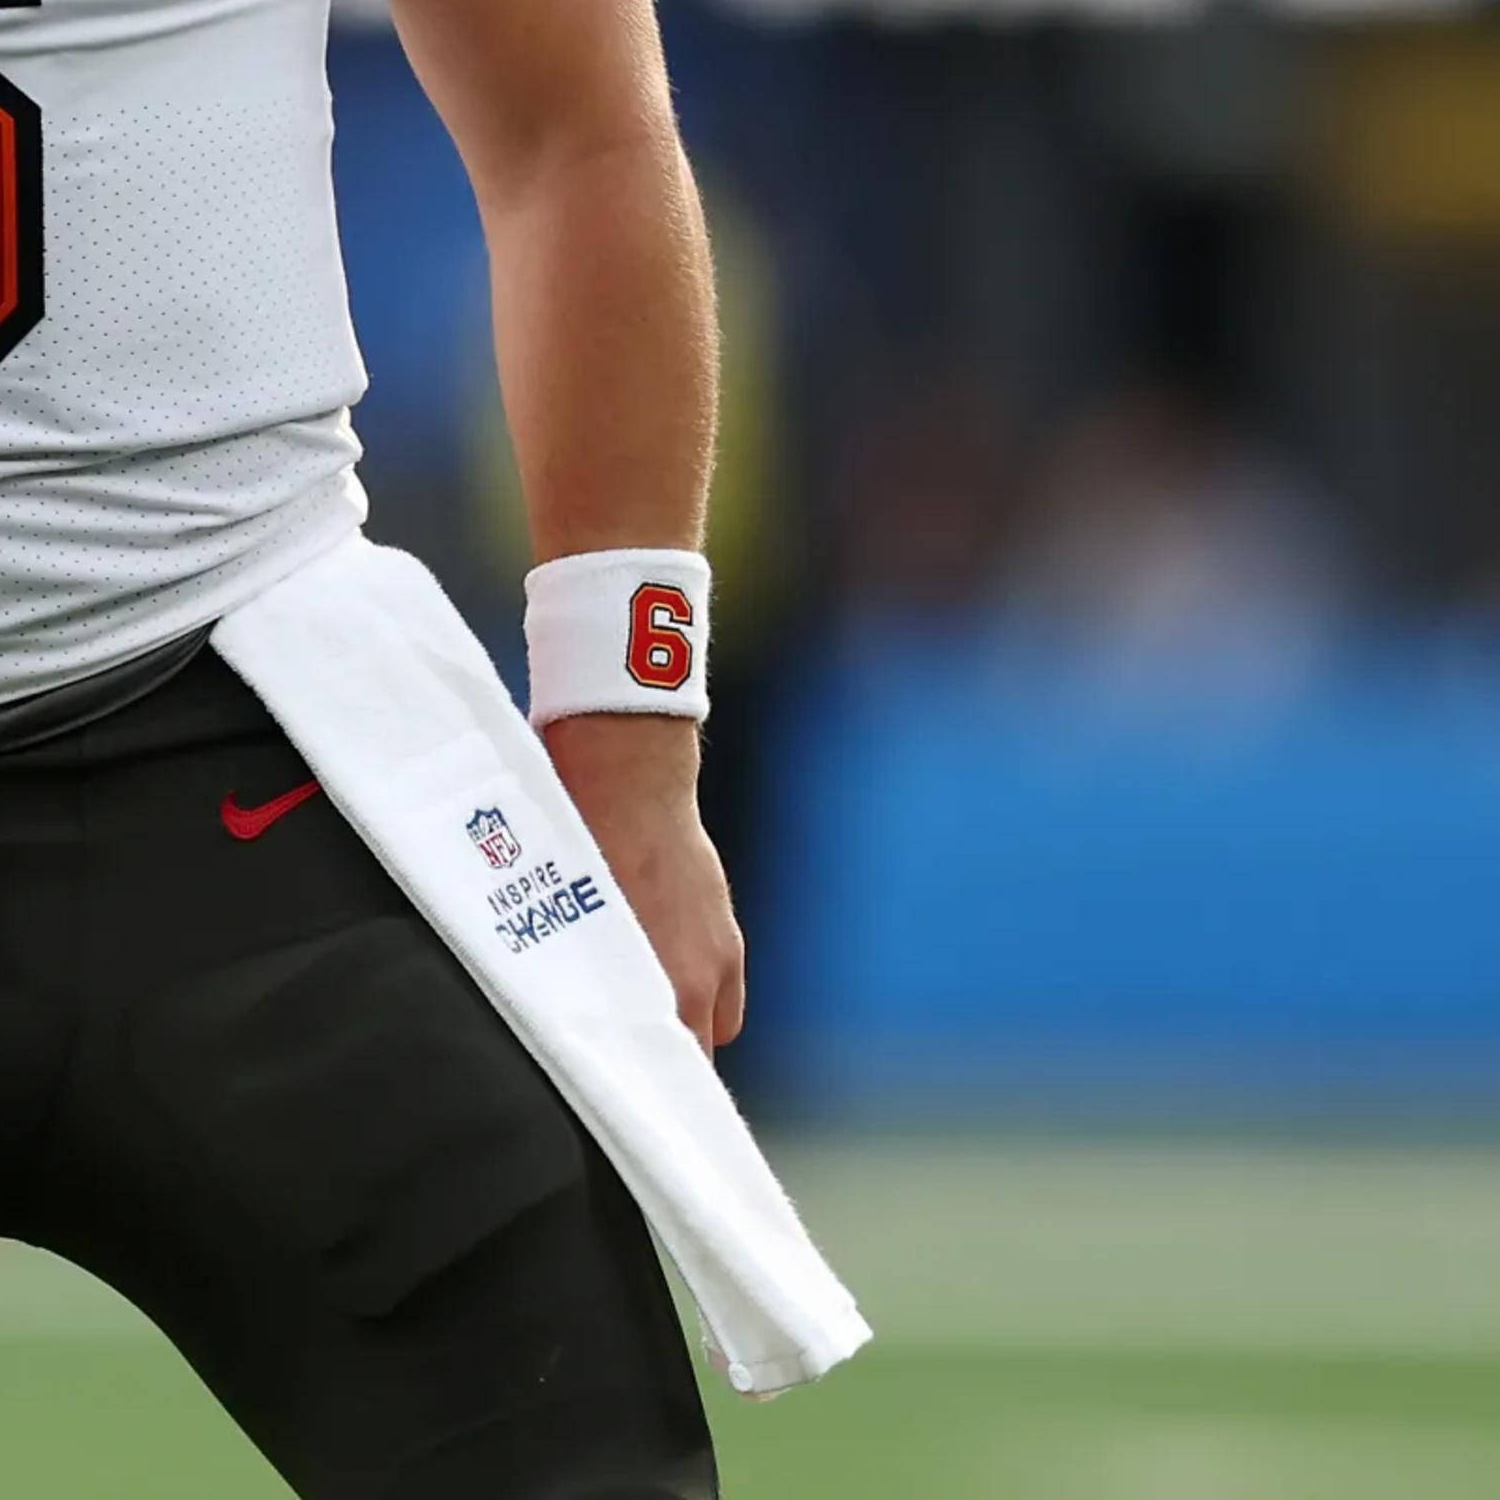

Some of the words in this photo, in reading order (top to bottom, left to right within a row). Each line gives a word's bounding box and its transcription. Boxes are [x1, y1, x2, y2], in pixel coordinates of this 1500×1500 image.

[626, 583, 693, 690] 6
[480, 833, 516, 866] NFL
[487, 862, 562, 915] INSPIRE
[496, 876, 605, 953] CHANGE
